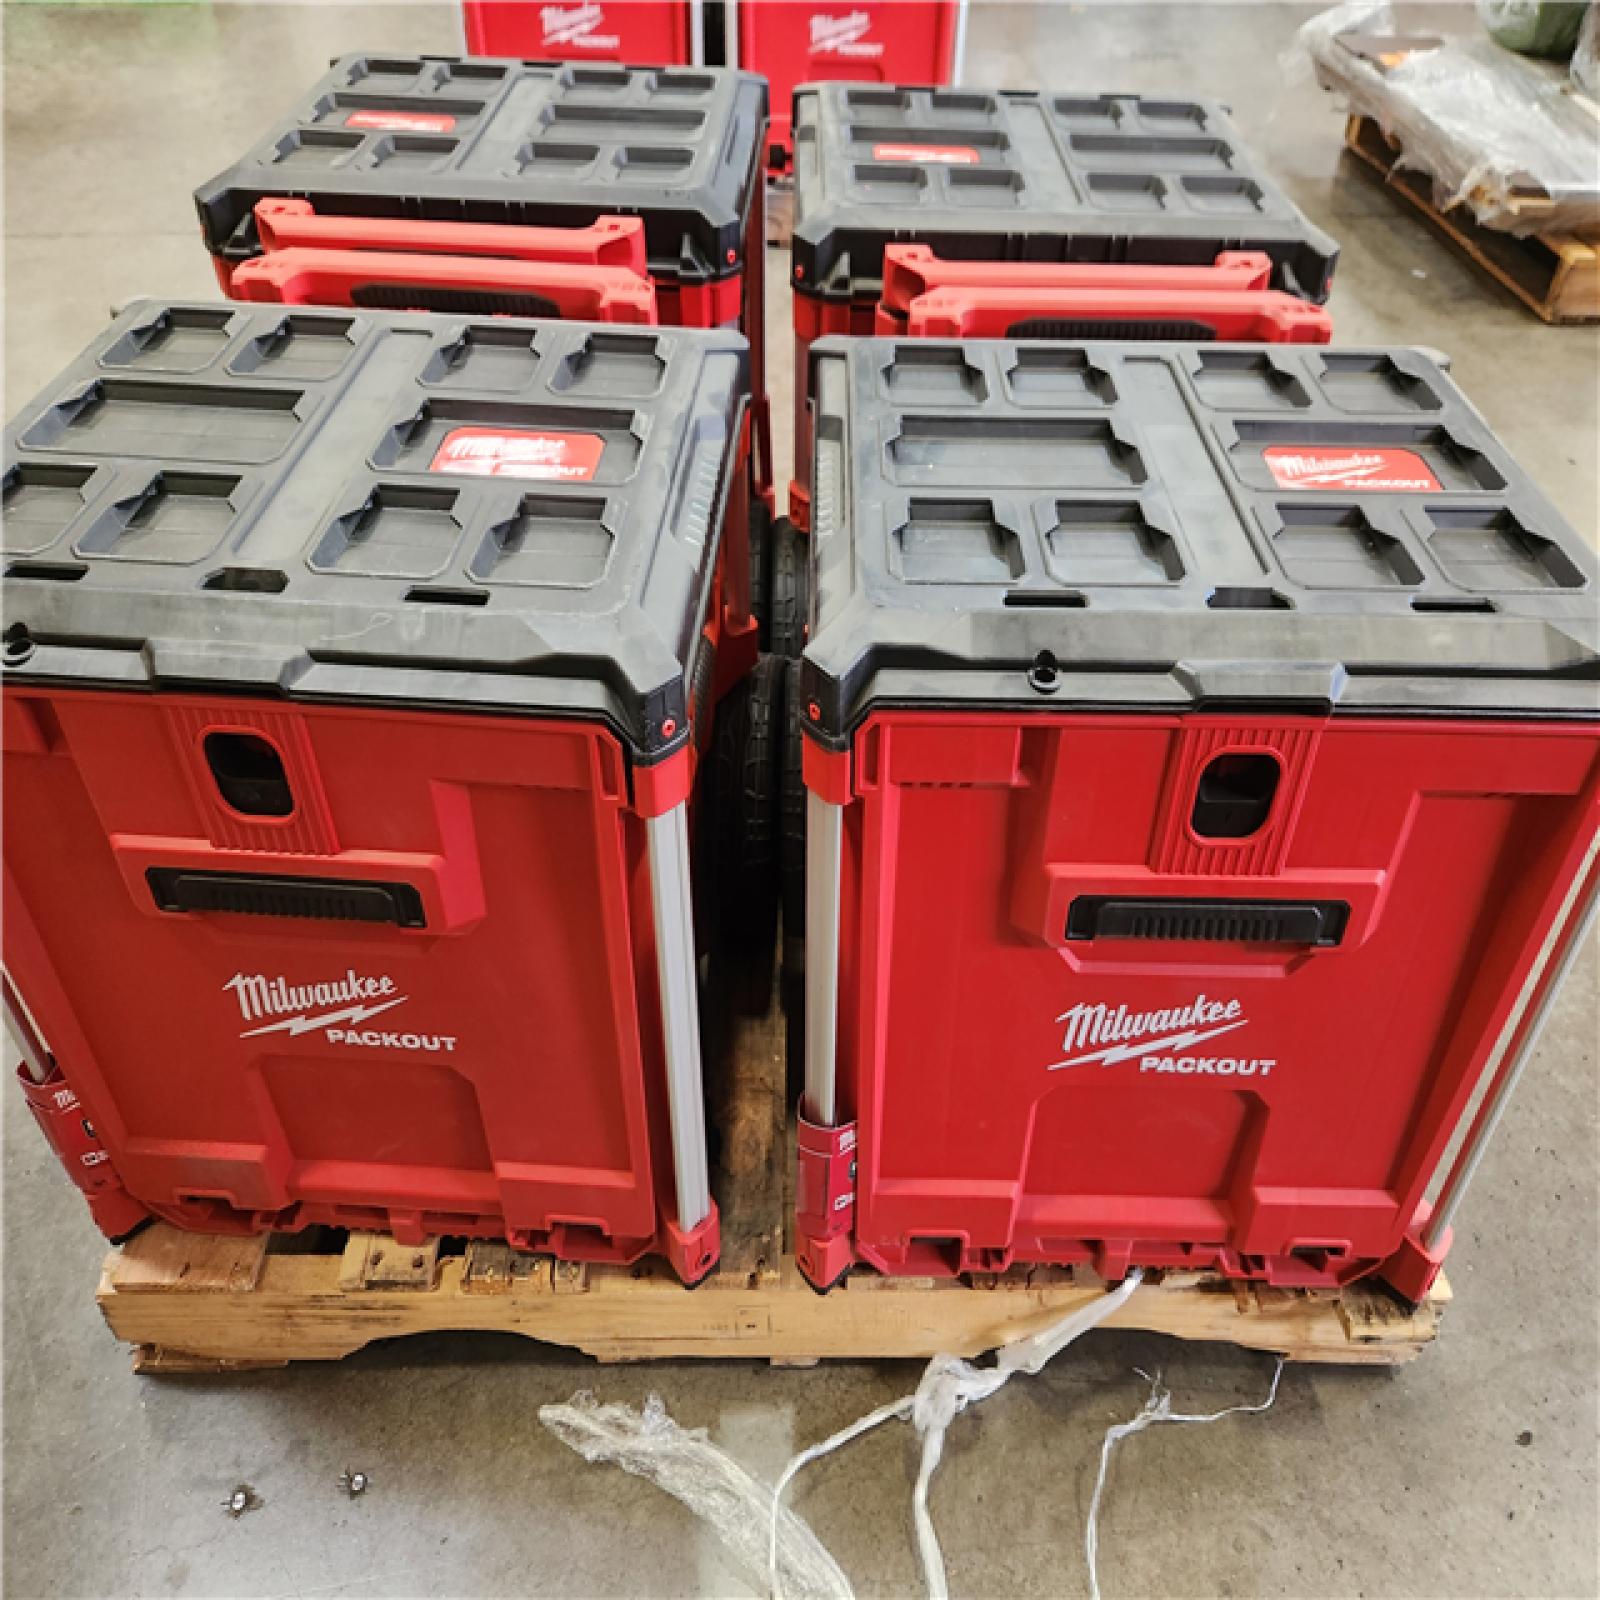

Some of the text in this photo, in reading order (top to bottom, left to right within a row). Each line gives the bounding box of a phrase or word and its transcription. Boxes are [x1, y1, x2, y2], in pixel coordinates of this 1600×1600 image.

[222, 968, 398, 1021] Milwaukee
[326, 1029, 457, 1051] PACKOUT
[1055, 994, 1242, 1053] Milwaukee
[1139, 1056, 1277, 1076] PACKOUT
